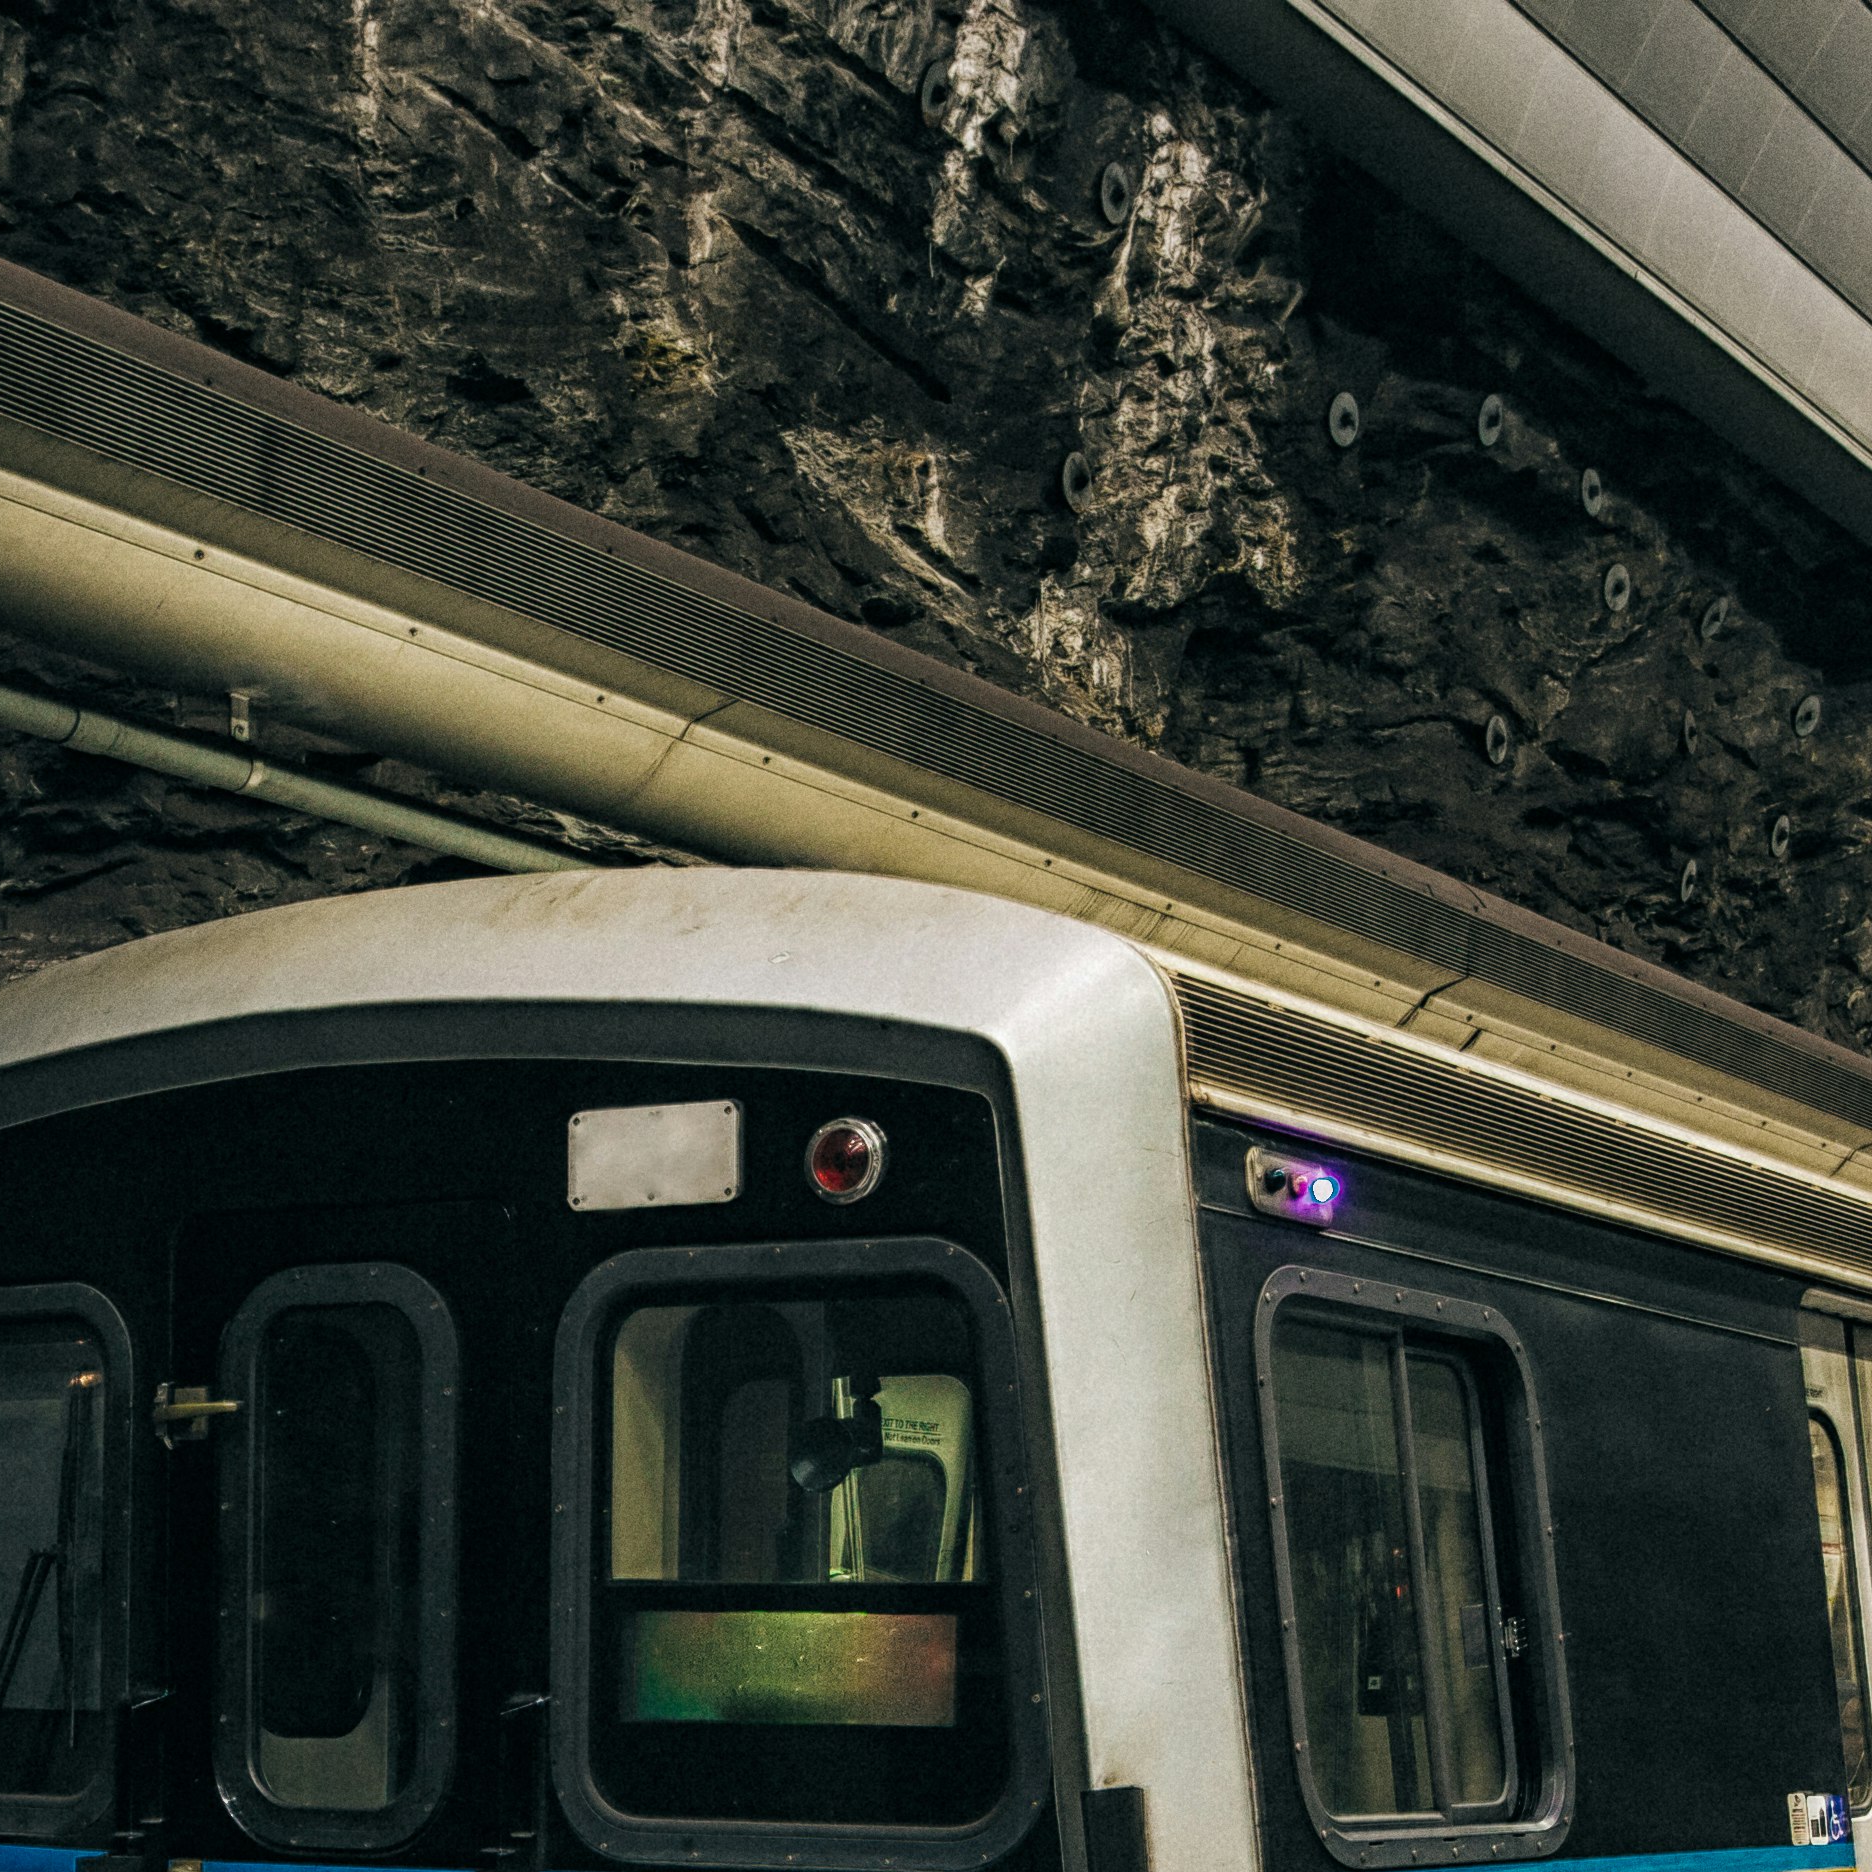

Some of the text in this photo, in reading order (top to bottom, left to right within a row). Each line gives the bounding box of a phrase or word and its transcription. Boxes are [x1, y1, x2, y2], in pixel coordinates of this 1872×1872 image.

[881, 1418, 894, 1428] XIT
[895, 1419, 904, 1429] TO
[905, 1420, 918, 1431] THE
